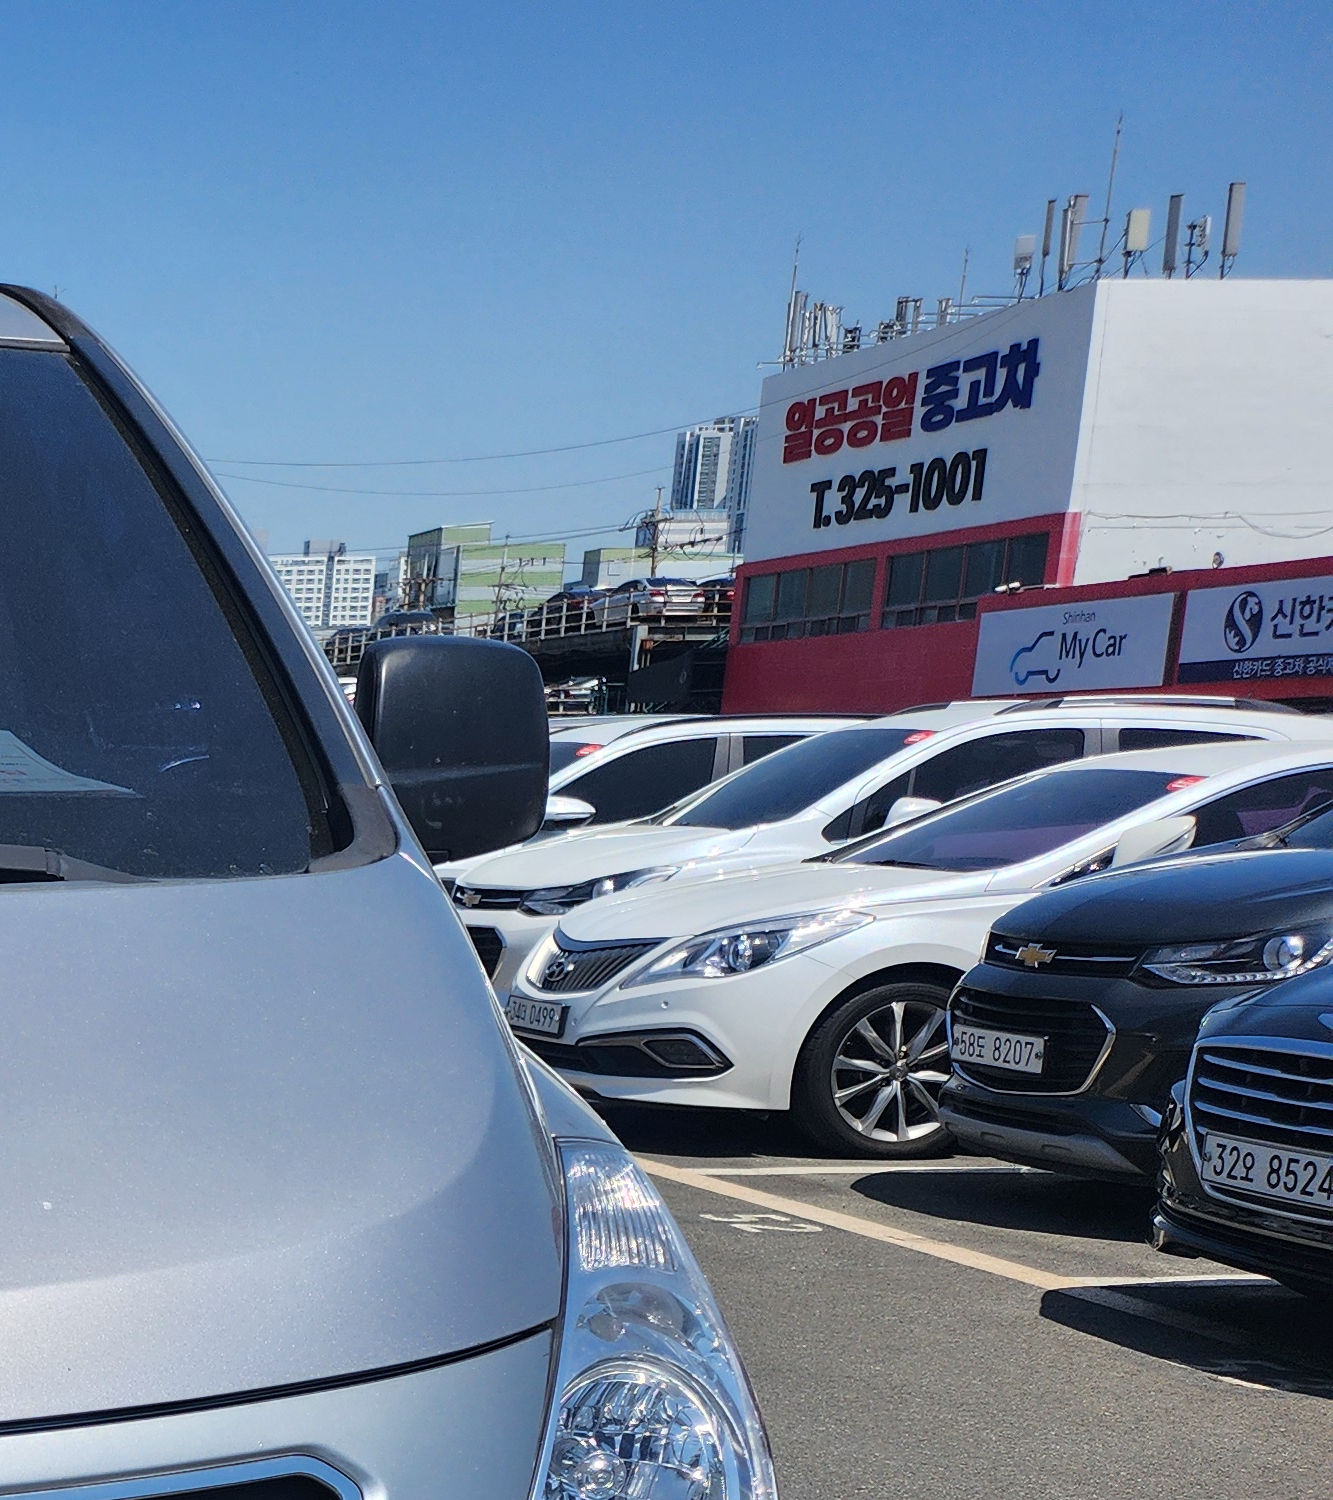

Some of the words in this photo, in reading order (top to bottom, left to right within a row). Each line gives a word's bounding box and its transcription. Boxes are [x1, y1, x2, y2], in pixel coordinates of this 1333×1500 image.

[783, 371, 919, 464] 일공공일
[920, 338, 1040, 433] 중고차
[810, 448, 988, 529] T.325-1001
[1063, 610, 1096, 625] Shinhan
[1233, 659, 1271, 678] 신한카드
[1273, 657, 1304, 677] 중고차
[530, 1004, 555, 1028] 0499
[959, 1031, 985, 1058] 58도
[992, 1037, 1034, 1066] 8207
[1213, 1143, 1255, 1183] 32오
[1266, 1154, 1333, 1201] 8524
